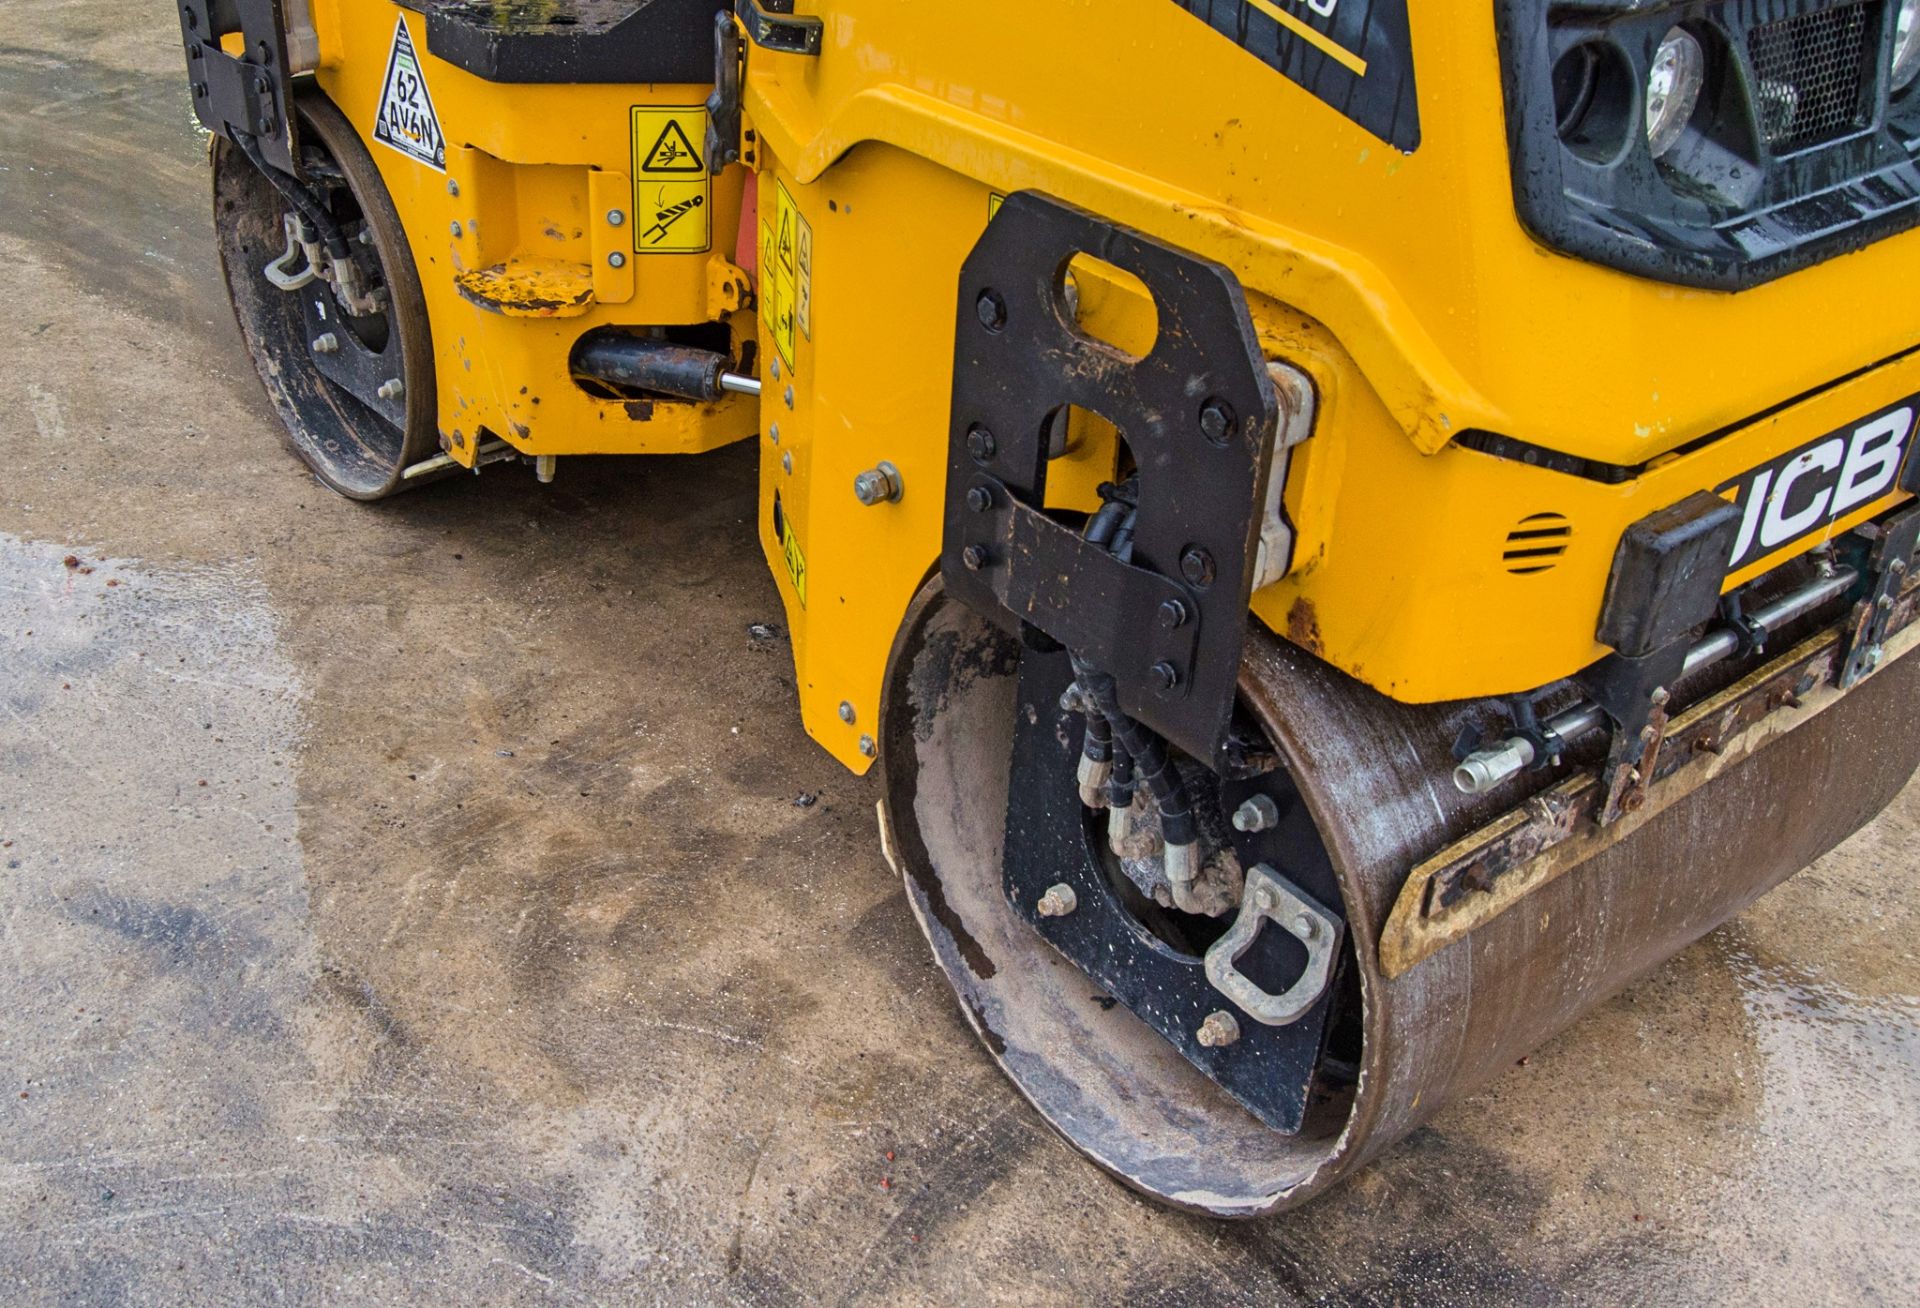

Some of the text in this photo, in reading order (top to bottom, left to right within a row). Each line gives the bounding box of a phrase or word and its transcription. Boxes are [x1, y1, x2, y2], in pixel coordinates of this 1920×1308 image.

[397, 70, 419, 110] 62
[390, 101, 434, 151] AV6N
[1728, 406, 1913, 568] JCB
